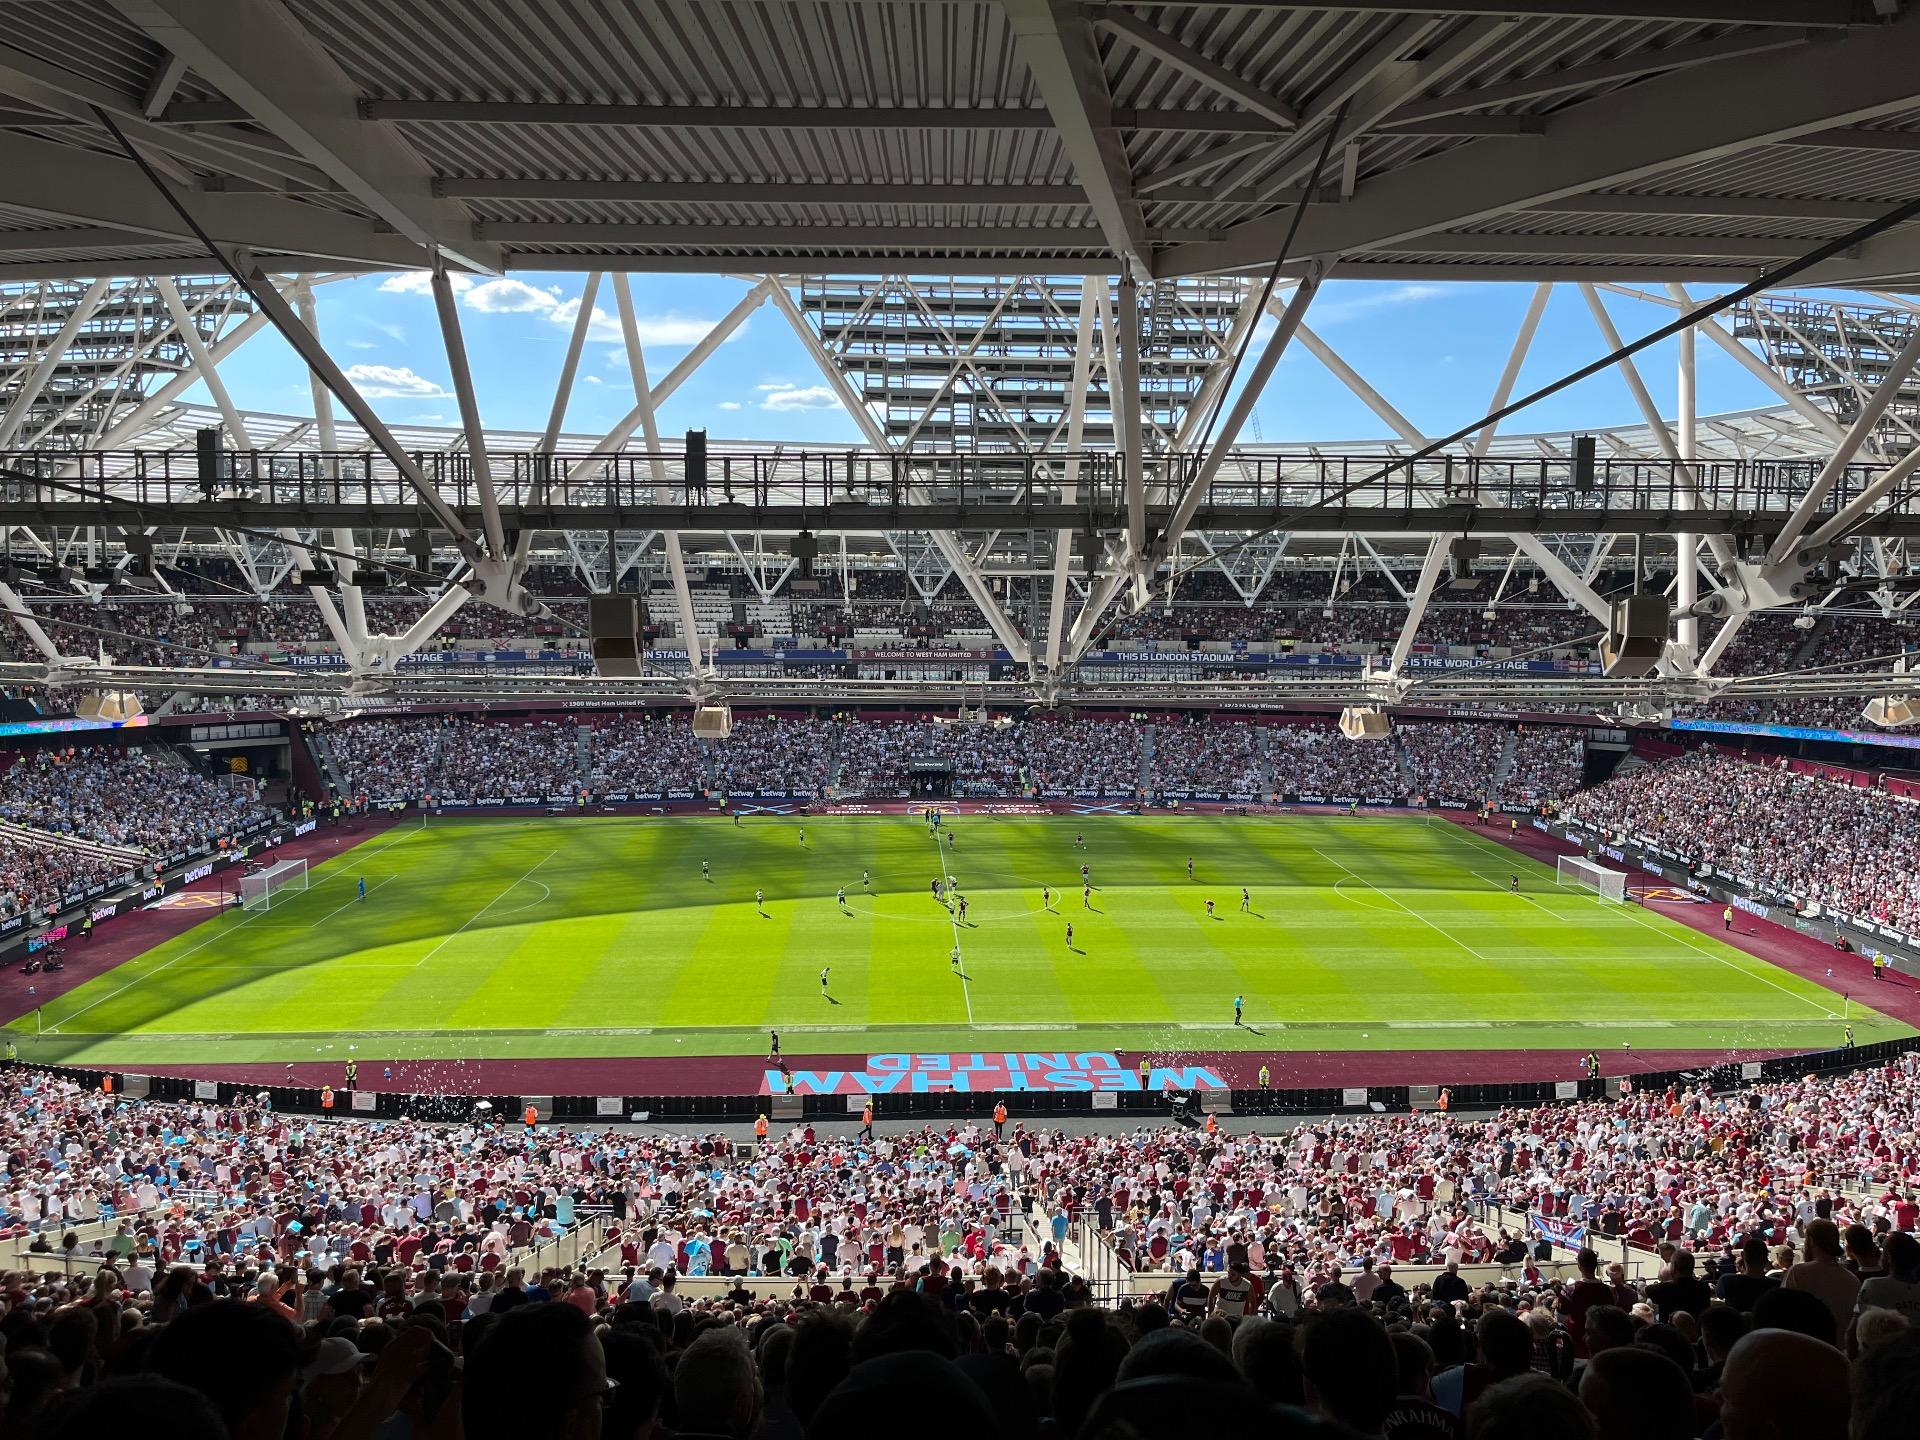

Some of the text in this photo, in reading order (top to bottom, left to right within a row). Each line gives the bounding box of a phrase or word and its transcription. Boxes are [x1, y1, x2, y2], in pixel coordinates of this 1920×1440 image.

[408, 653, 444, 663] STAGE
[655, 650, 690, 659] STADIU
[1117, 652, 1235, 663] THIS IS LONDON STADIUM
[292, 655, 347, 665] THIS IS TH
[1410, 658, 1420, 667] IS
[1422, 658, 1443, 668] THE
[585, 700, 601, 708] West
[602, 700, 615, 708] Ham
[616, 700, 637, 708] United
[1478, 711, 1492, 719] Cup
[605, 793, 629, 801] etway
[635, 792, 662, 801] betway
[668, 791, 695, 800] betway
[729, 789, 755, 798] betway
[761, 789, 787, 798] betway
[1042, 788, 1068, 798] betway
[1073, 788, 1099, 798] betway
[1104, 789, 1131, 798] betway
[1164, 790, 1189, 800] betway
[1195, 790, 1222, 800] betway
[1227, 791, 1254, 801] betway
[441, 798, 469, 807] betway
[477, 796, 506, 806] betway
[512, 795, 540, 806] betway
[546, 794, 575, 804] betway
[1299, 793, 1326, 804] betway
[1332, 794, 1359, 805] betway
[1365, 795, 1393, 806] betway
[1439, 799, 1467, 810] betway
[1502, 803, 1531, 815] betway
[295, 820, 317, 837] betway
[1642, 859, 1663, 877] betway
[184, 863, 213, 884] betway
[87, 884, 105, 897] betway
[65, 892, 84, 905] betway
[1732, 894, 1769, 918] betway
[92, 904, 117, 922] betway
[1, 917, 22, 931] betway
[1852, 914, 1876, 933] betway
[1879, 925, 1904, 943] betway
[867, 1052, 1122, 1072] UNITED
[764, 1066, 1227, 1093] WEST HAM
[1807, 1205, 1813, 1214] 8
[1419, 1235, 1426, 1246] 6
[1226, 1290, 1243, 1301] NIKE
